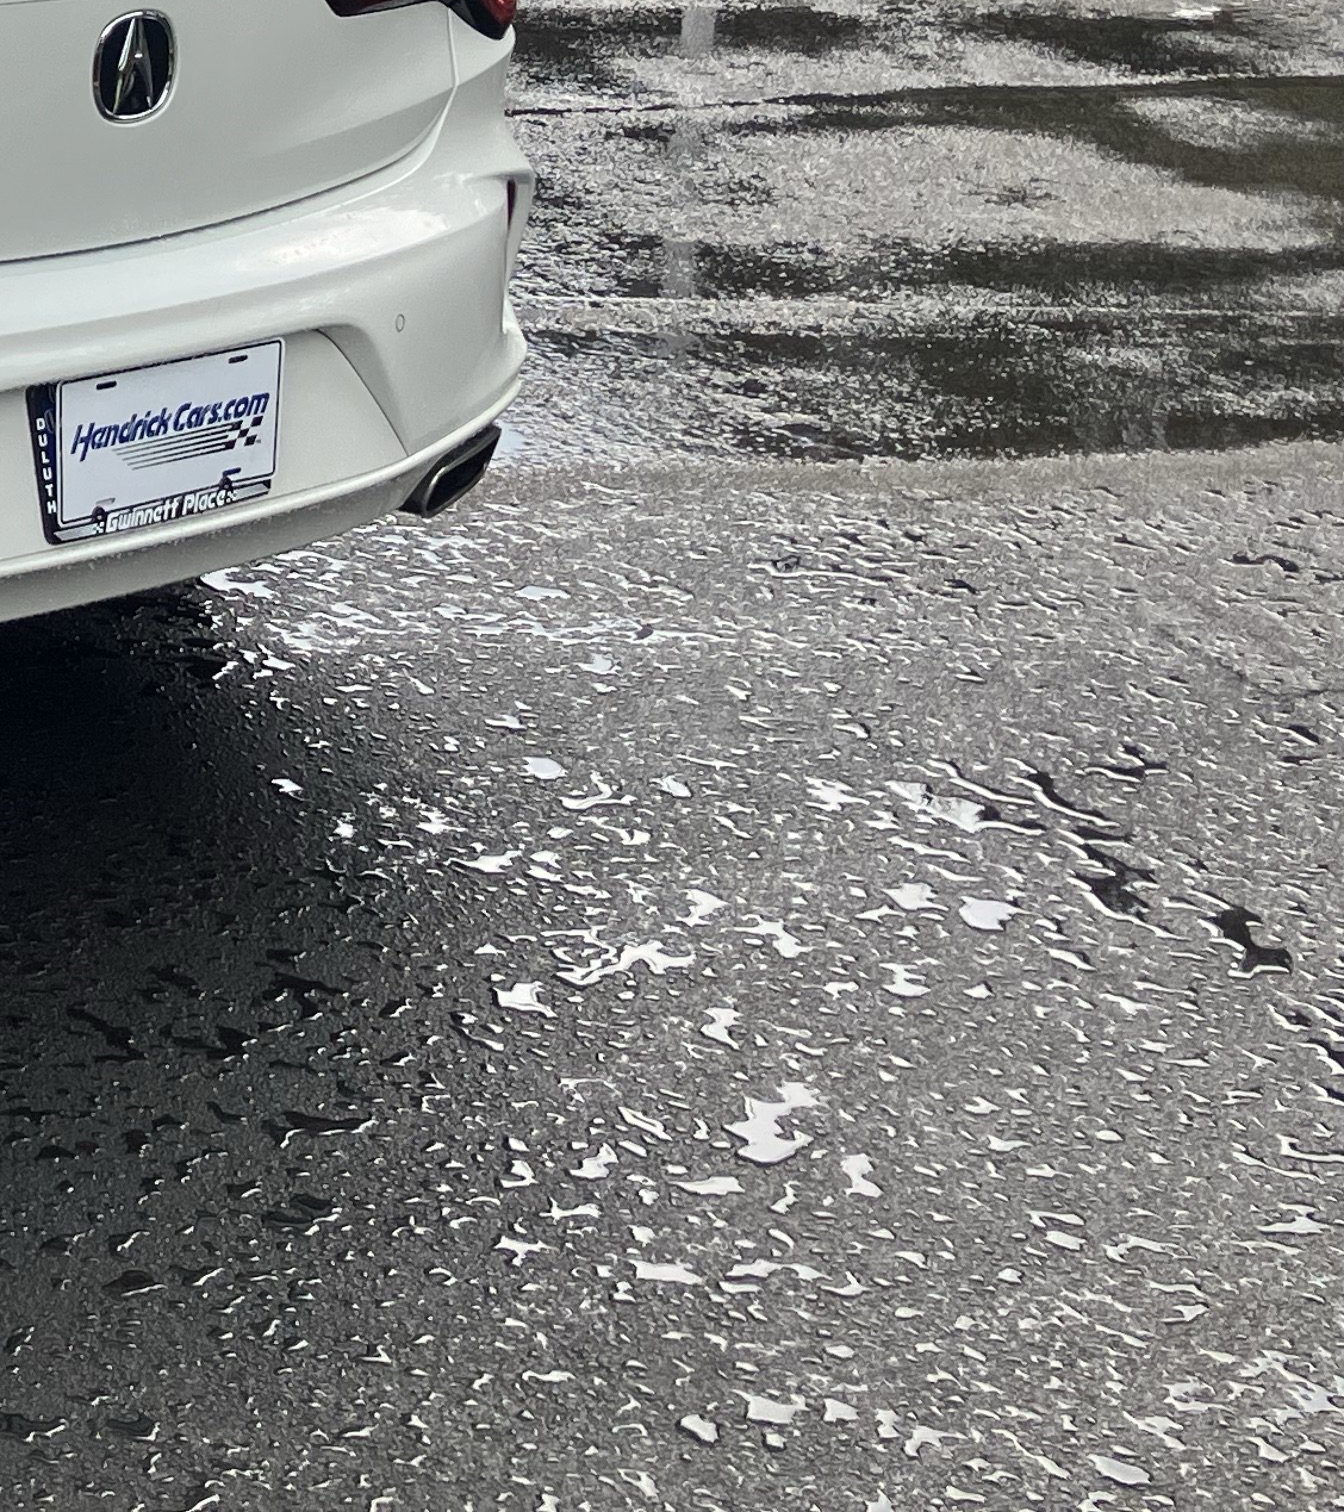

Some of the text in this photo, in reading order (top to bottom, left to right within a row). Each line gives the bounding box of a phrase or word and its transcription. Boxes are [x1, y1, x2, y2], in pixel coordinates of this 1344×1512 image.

[36, 417, 57, 514] DULUTH
[105, 490, 226, 533] Gwinnett Place
